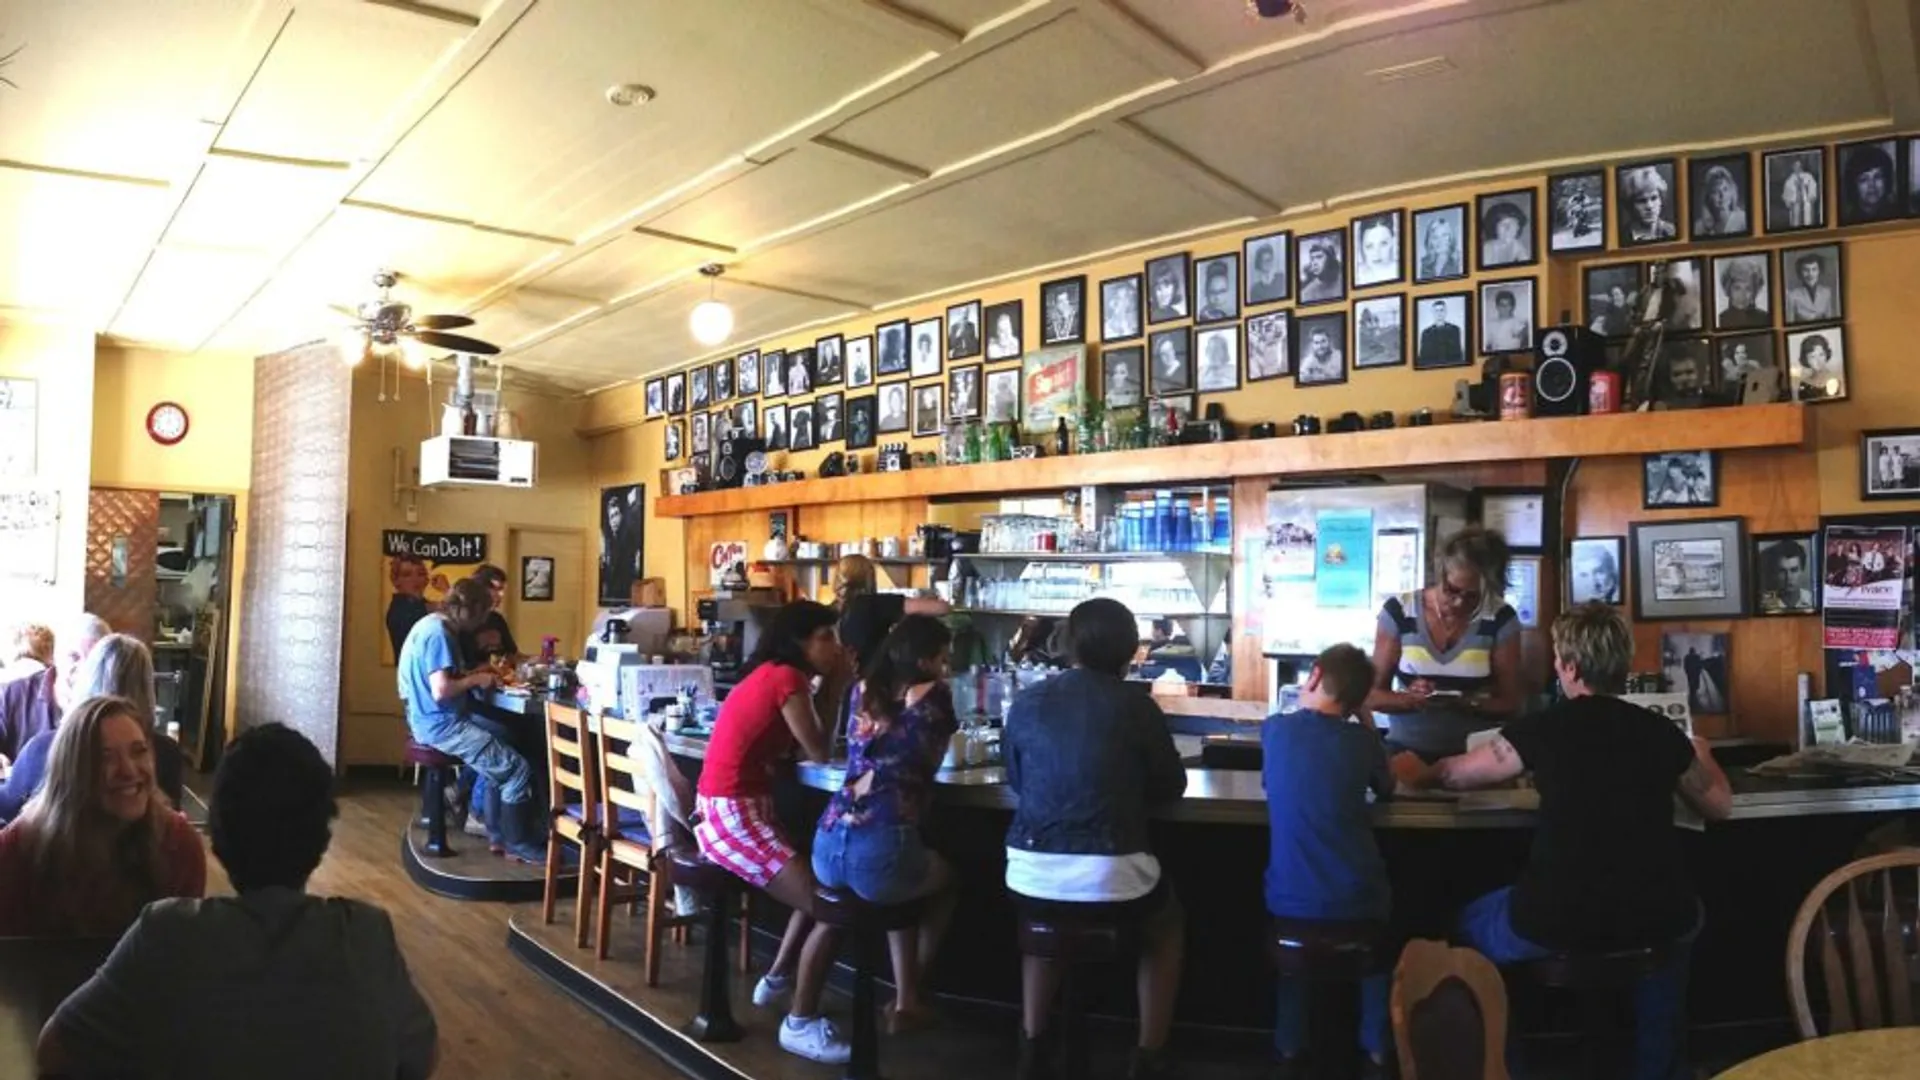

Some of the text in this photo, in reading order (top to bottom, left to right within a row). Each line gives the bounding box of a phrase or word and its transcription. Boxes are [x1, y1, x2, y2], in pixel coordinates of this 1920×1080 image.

[387, 533, 410, 552] We
[412, 537, 438, 556] Can
[440, 537, 459, 557] Do
